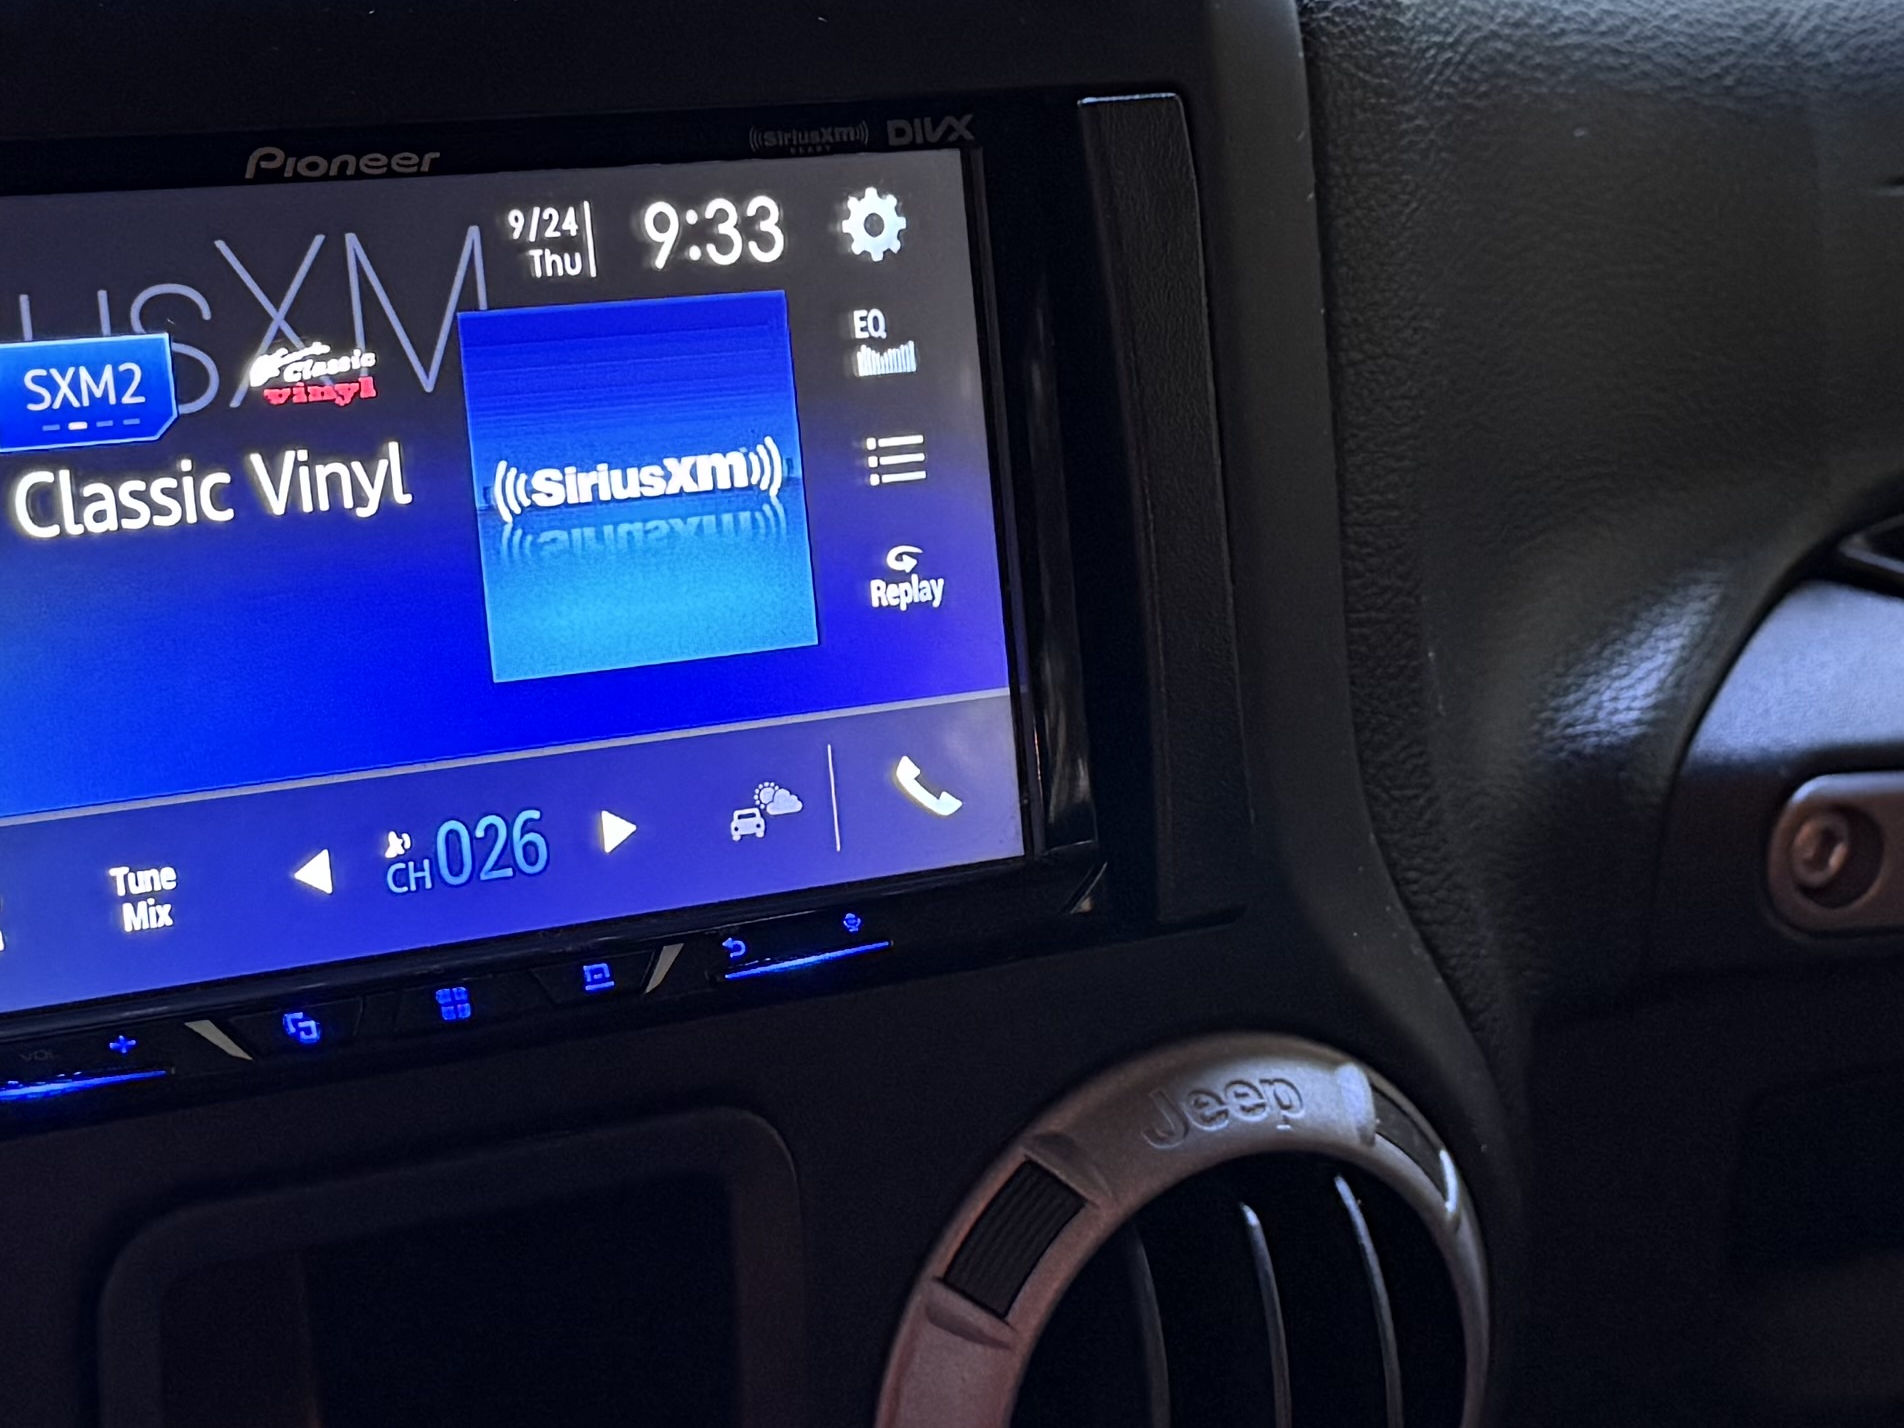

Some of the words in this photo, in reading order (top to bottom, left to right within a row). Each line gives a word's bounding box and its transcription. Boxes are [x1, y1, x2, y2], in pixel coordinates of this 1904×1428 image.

[245, 146, 441, 179] Pioneer
[507, 206, 579, 242] 9/24
[644, 195, 785, 270] 9:33
[527, 248, 583, 278] Thu
[853, 308, 887, 339] EQ
[23, 362, 146, 411] SXM2
[13, 458, 235, 539] Classic
[248, 440, 413, 518] Vinyl
[869, 573, 945, 612] Replay
[386, 858, 433, 894] CH
[436, 809, 549, 886] 026
[108, 866, 178, 897] Tune
[122, 897, 174, 933] Mix
[1141, 1076, 1305, 1149] Jeep
